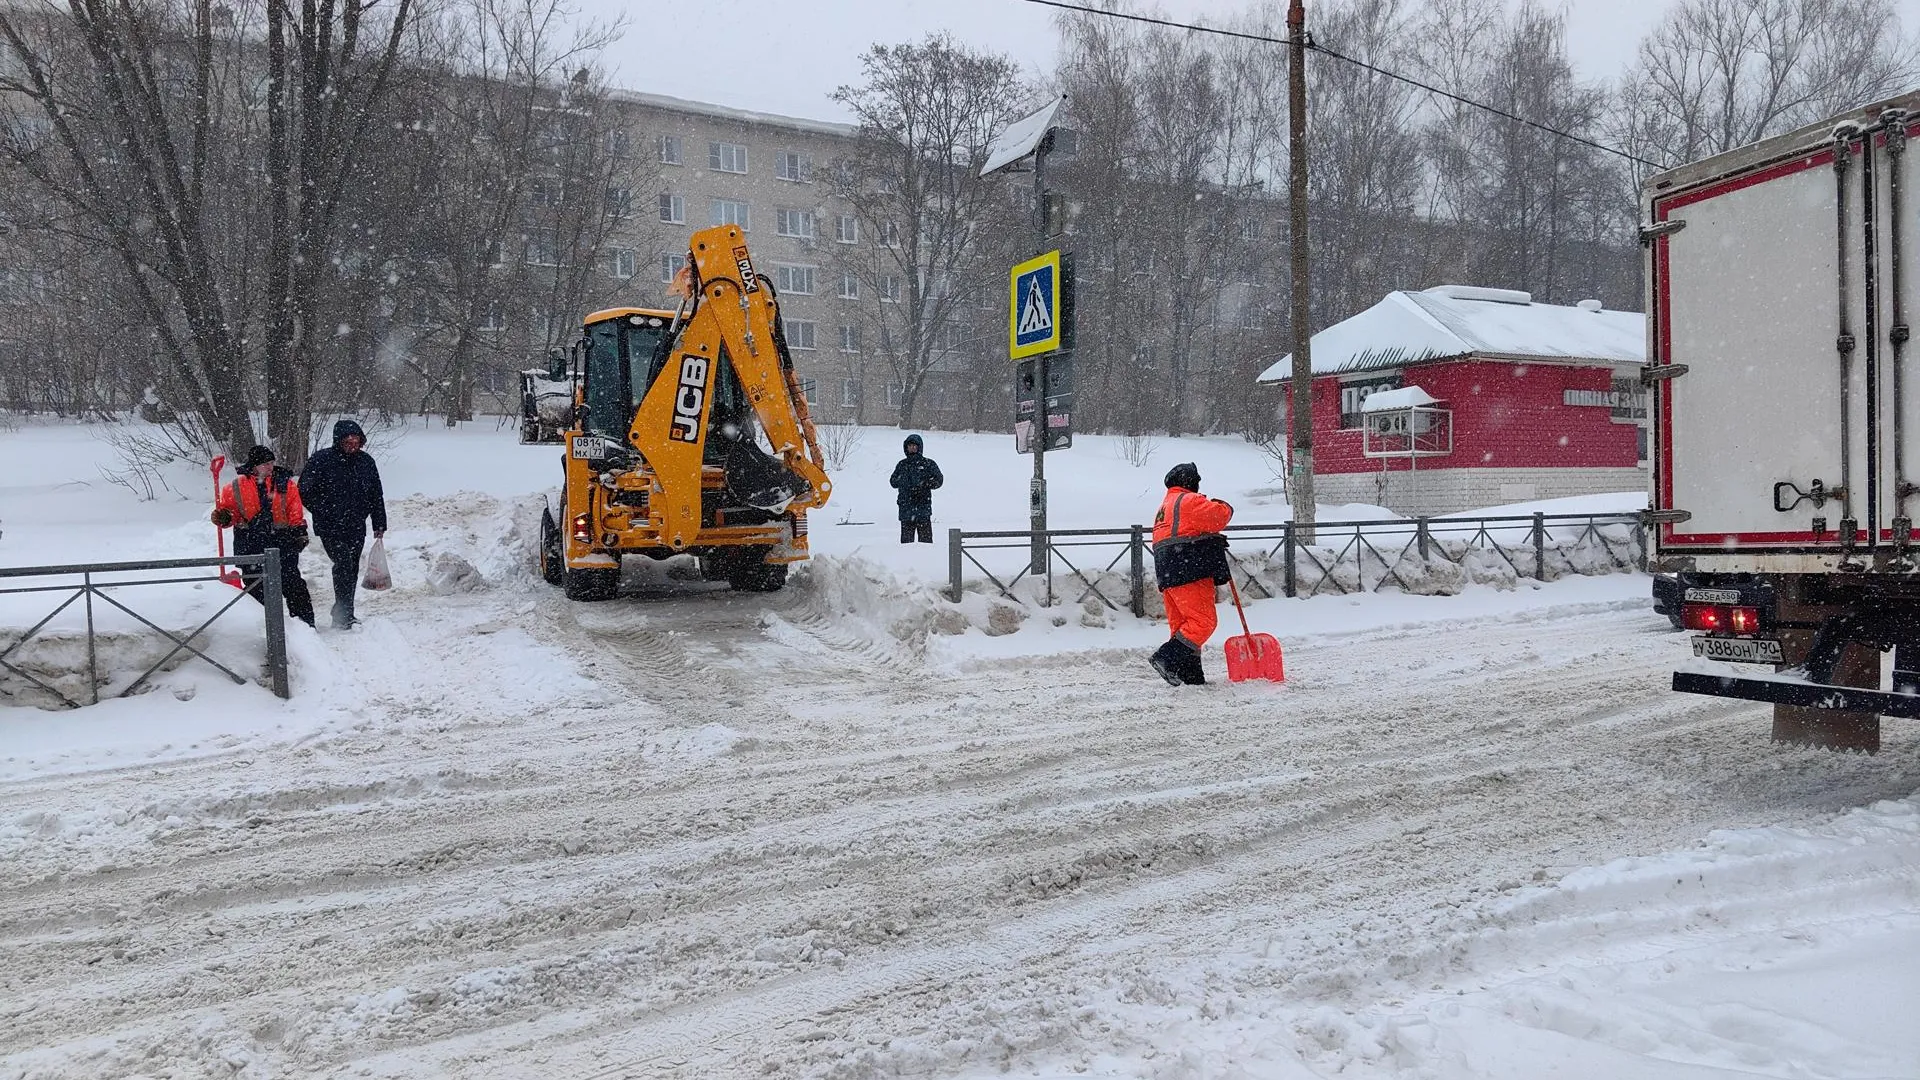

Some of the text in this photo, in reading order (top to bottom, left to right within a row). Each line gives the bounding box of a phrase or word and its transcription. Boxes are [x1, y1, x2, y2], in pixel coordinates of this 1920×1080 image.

[738, 260, 757, 290] 3CX
[675, 358, 707, 441] JCB
[577, 438, 600, 447] 0814
[592, 448, 602, 456] 77
